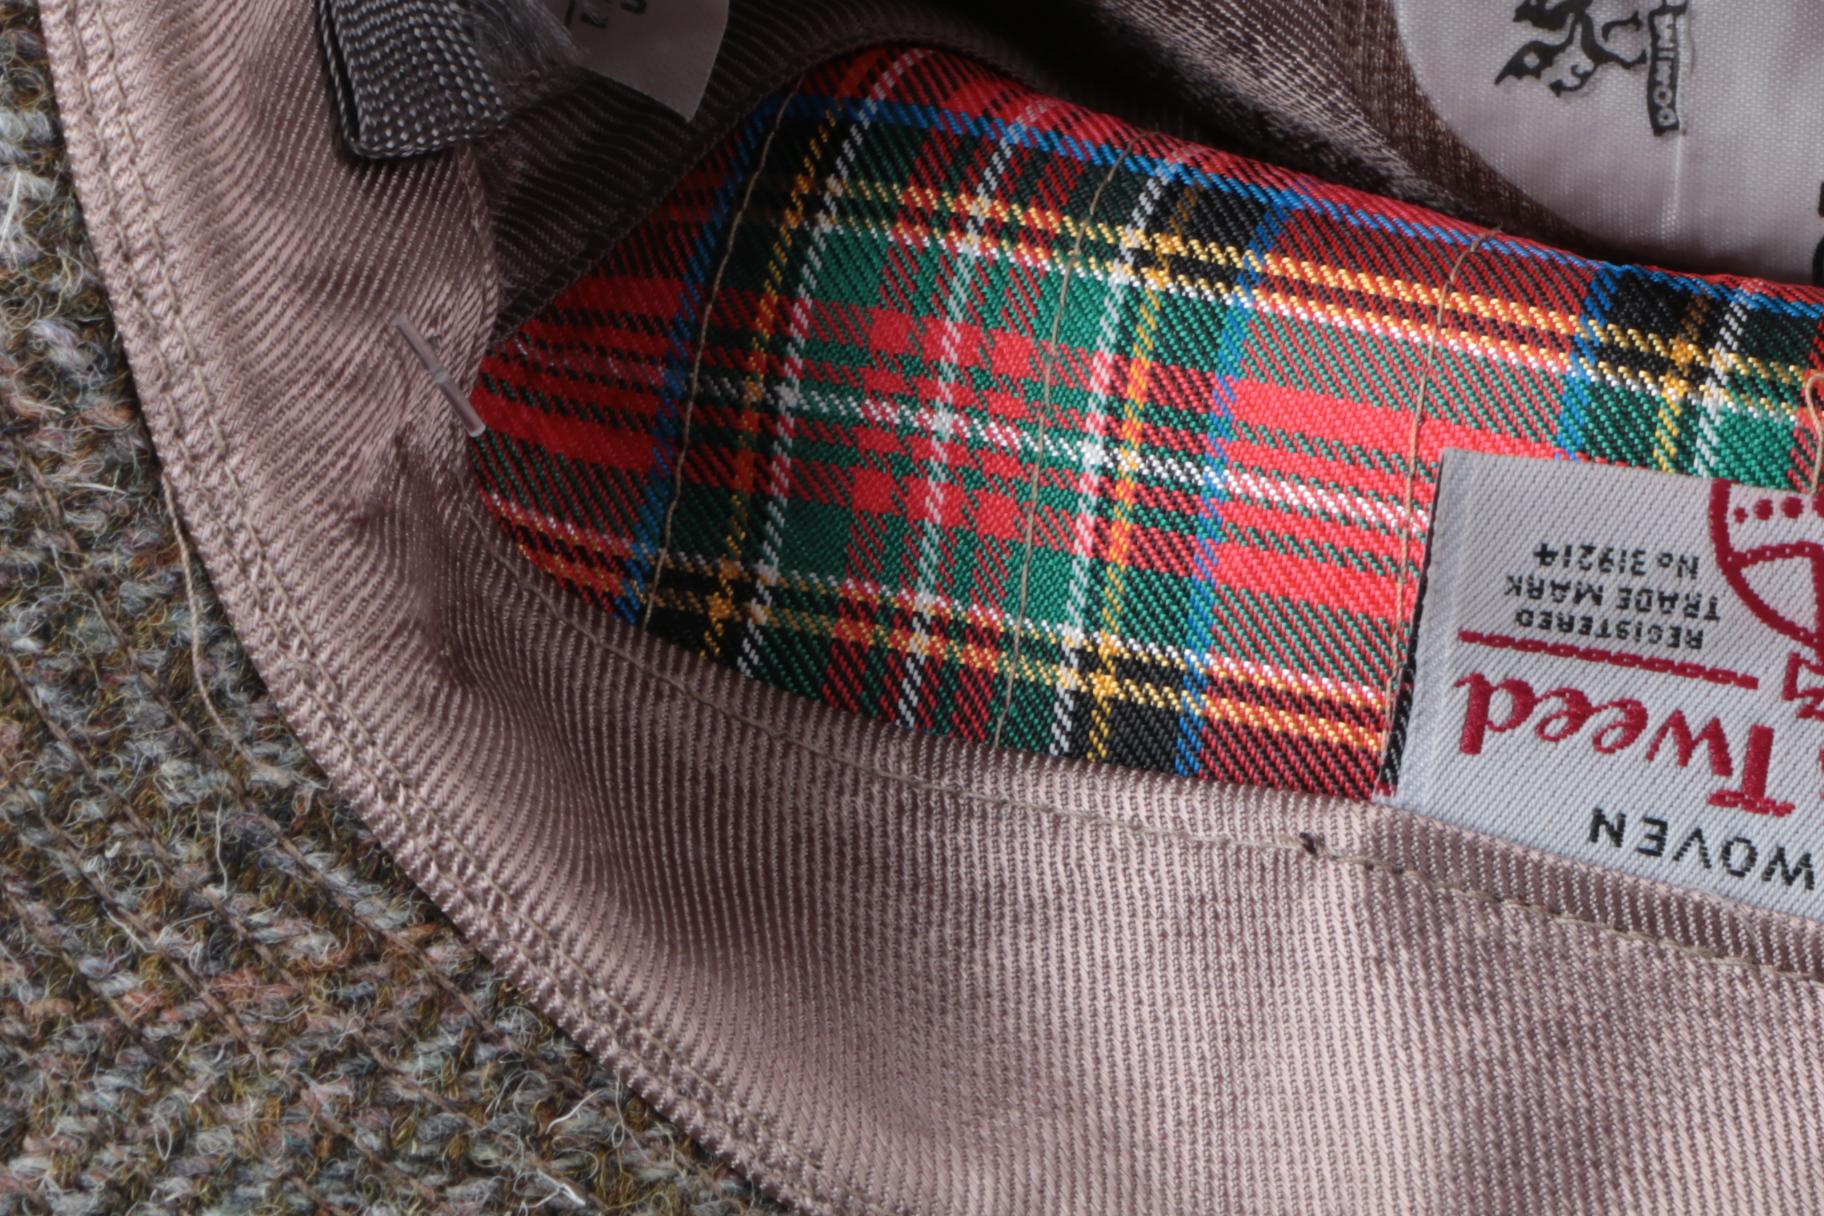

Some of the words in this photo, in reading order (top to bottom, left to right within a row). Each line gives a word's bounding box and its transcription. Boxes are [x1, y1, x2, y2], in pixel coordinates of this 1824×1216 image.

[1657, 551, 1701, 580] No
[1505, 575, 1604, 606] MARK
[1616, 584, 1721, 623] TRADE
[1515, 609, 1704, 650] REGISTERED
[1453, 672, 1797, 818] Tweed
[1588, 807, 1815, 887] WOVEN
